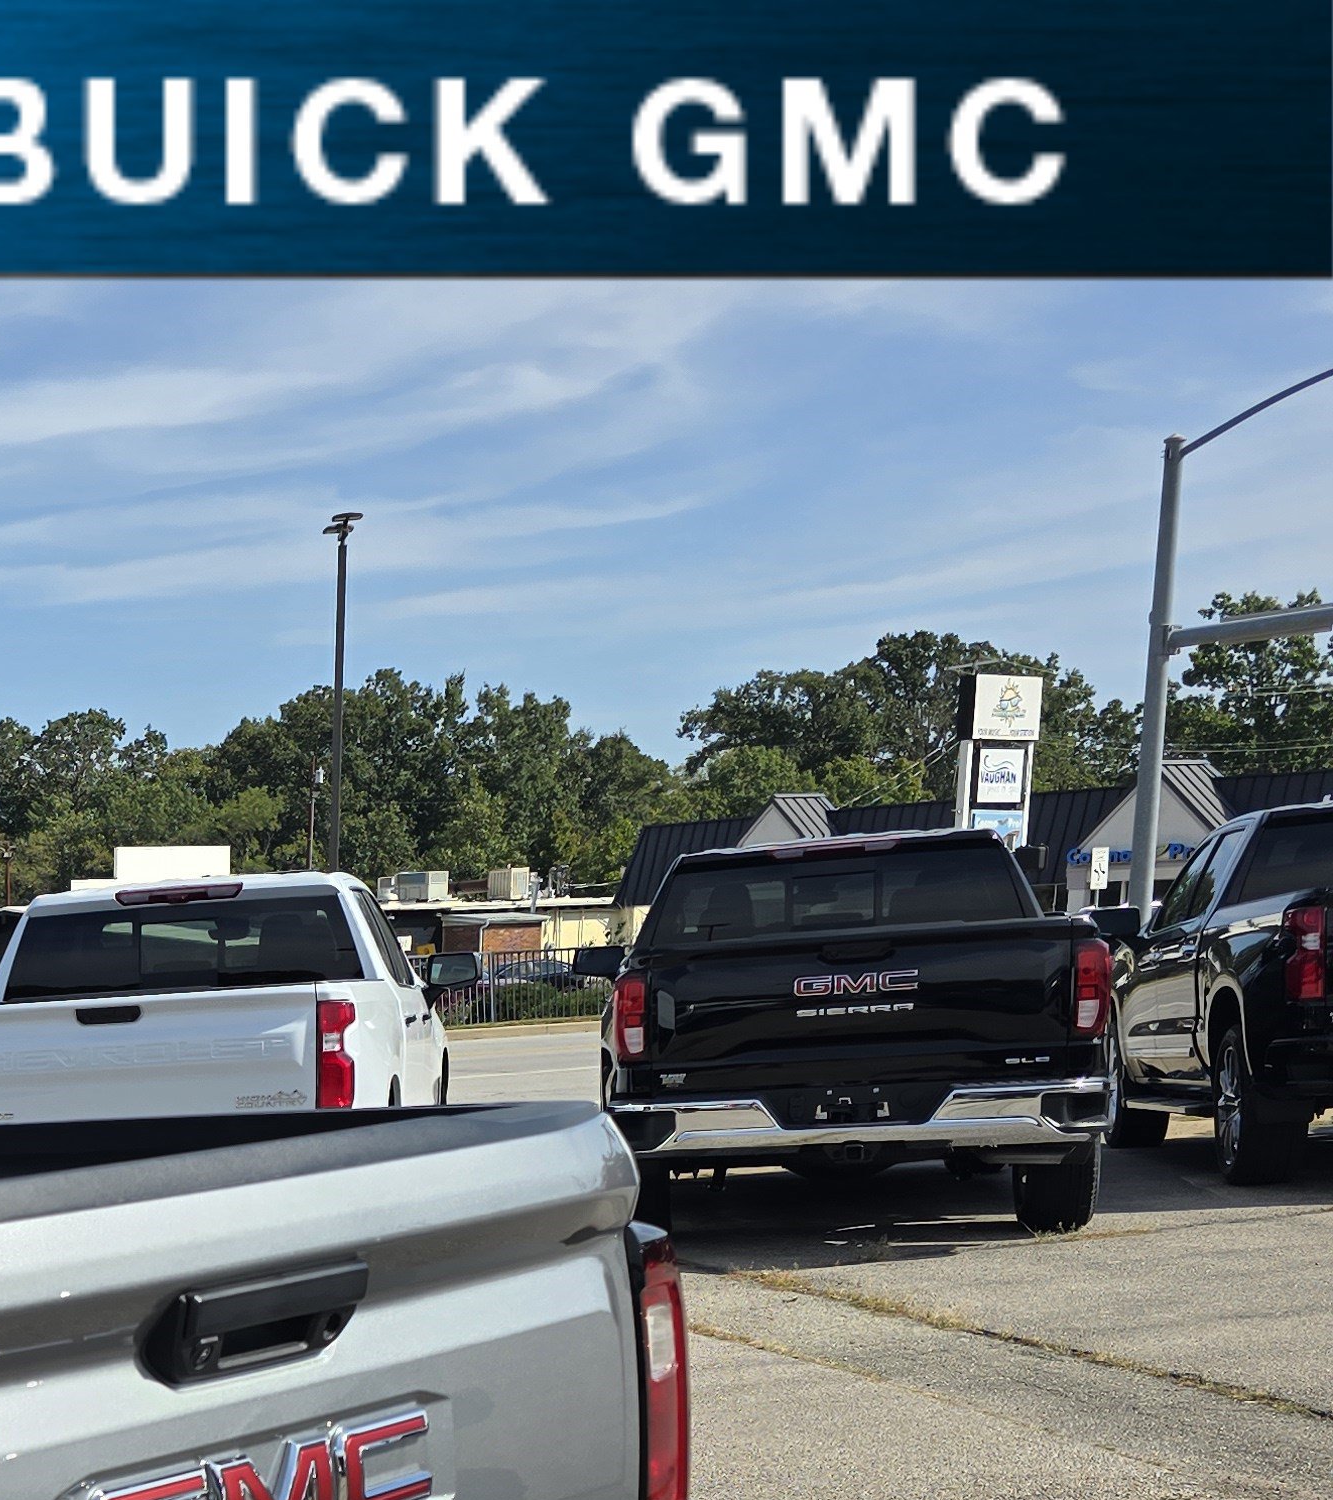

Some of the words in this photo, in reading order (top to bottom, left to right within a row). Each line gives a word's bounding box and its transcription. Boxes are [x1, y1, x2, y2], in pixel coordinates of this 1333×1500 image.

[980, 770, 1017, 784] VAUGHAN
[793, 968, 919, 998] GMC
[796, 1002, 915, 1018] SIERRA
